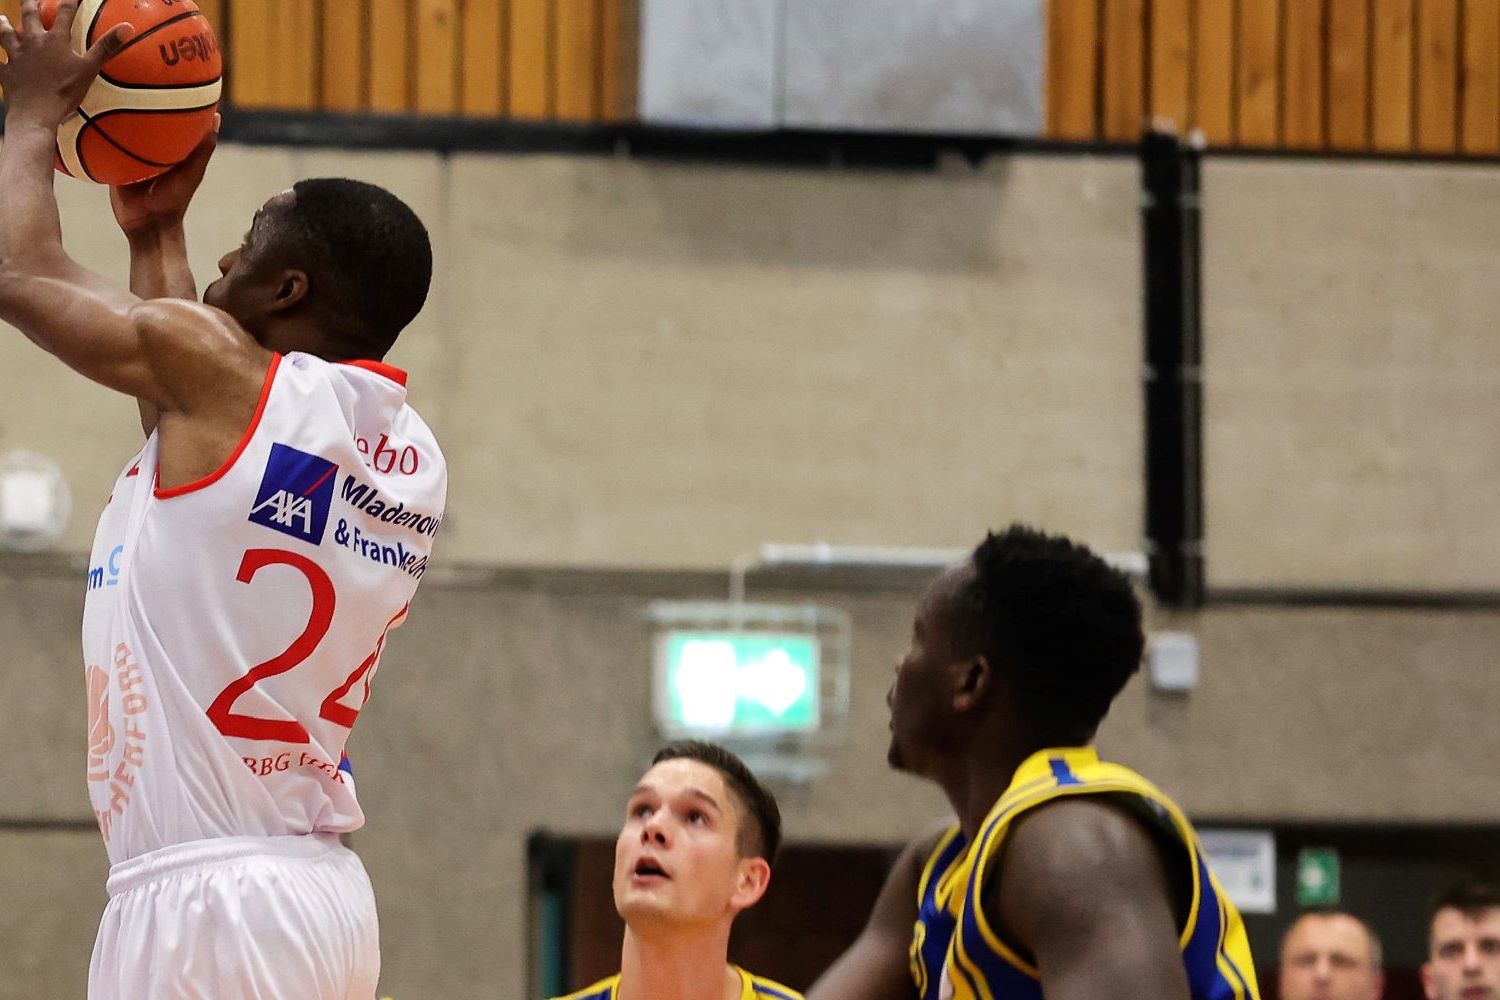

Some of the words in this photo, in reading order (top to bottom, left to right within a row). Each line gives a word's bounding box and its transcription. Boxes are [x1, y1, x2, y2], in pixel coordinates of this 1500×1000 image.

[355, 433, 419, 475] ebo
[250, 489, 312, 535] AXA
[334, 518, 350, 548] &
[206, 548, 409, 744] 24
[242, 752, 291, 777] BBG
